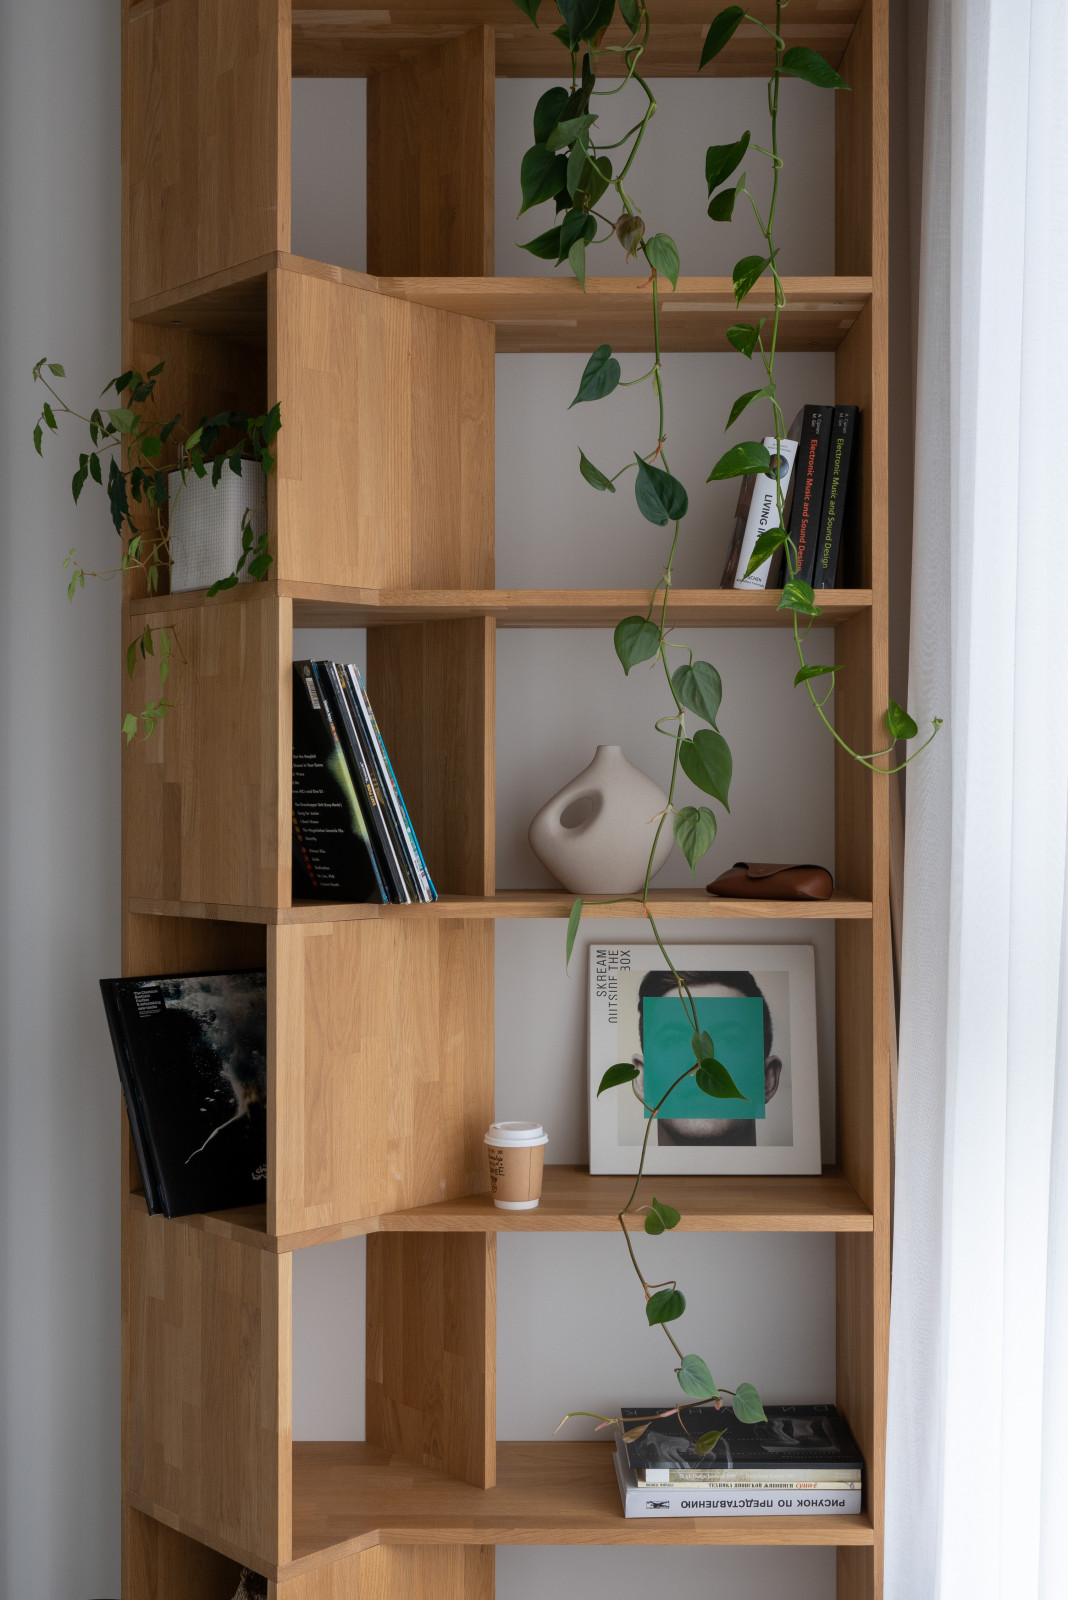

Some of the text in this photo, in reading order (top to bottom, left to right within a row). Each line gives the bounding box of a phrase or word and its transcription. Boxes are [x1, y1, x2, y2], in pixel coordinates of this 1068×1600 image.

[760, 494, 773, 526] LIVING
[797, 439, 818, 572] Electronic Music and Sound Design
[821, 438, 844, 569] Electronic Music and Sound Design
[596, 950, 607, 997] SKREAM
[608, 950, 618, 971] THE
[680, 1499, 845, 1509] РИСУНОК ПО ПРЕДСТАВЛЕНИЮ
